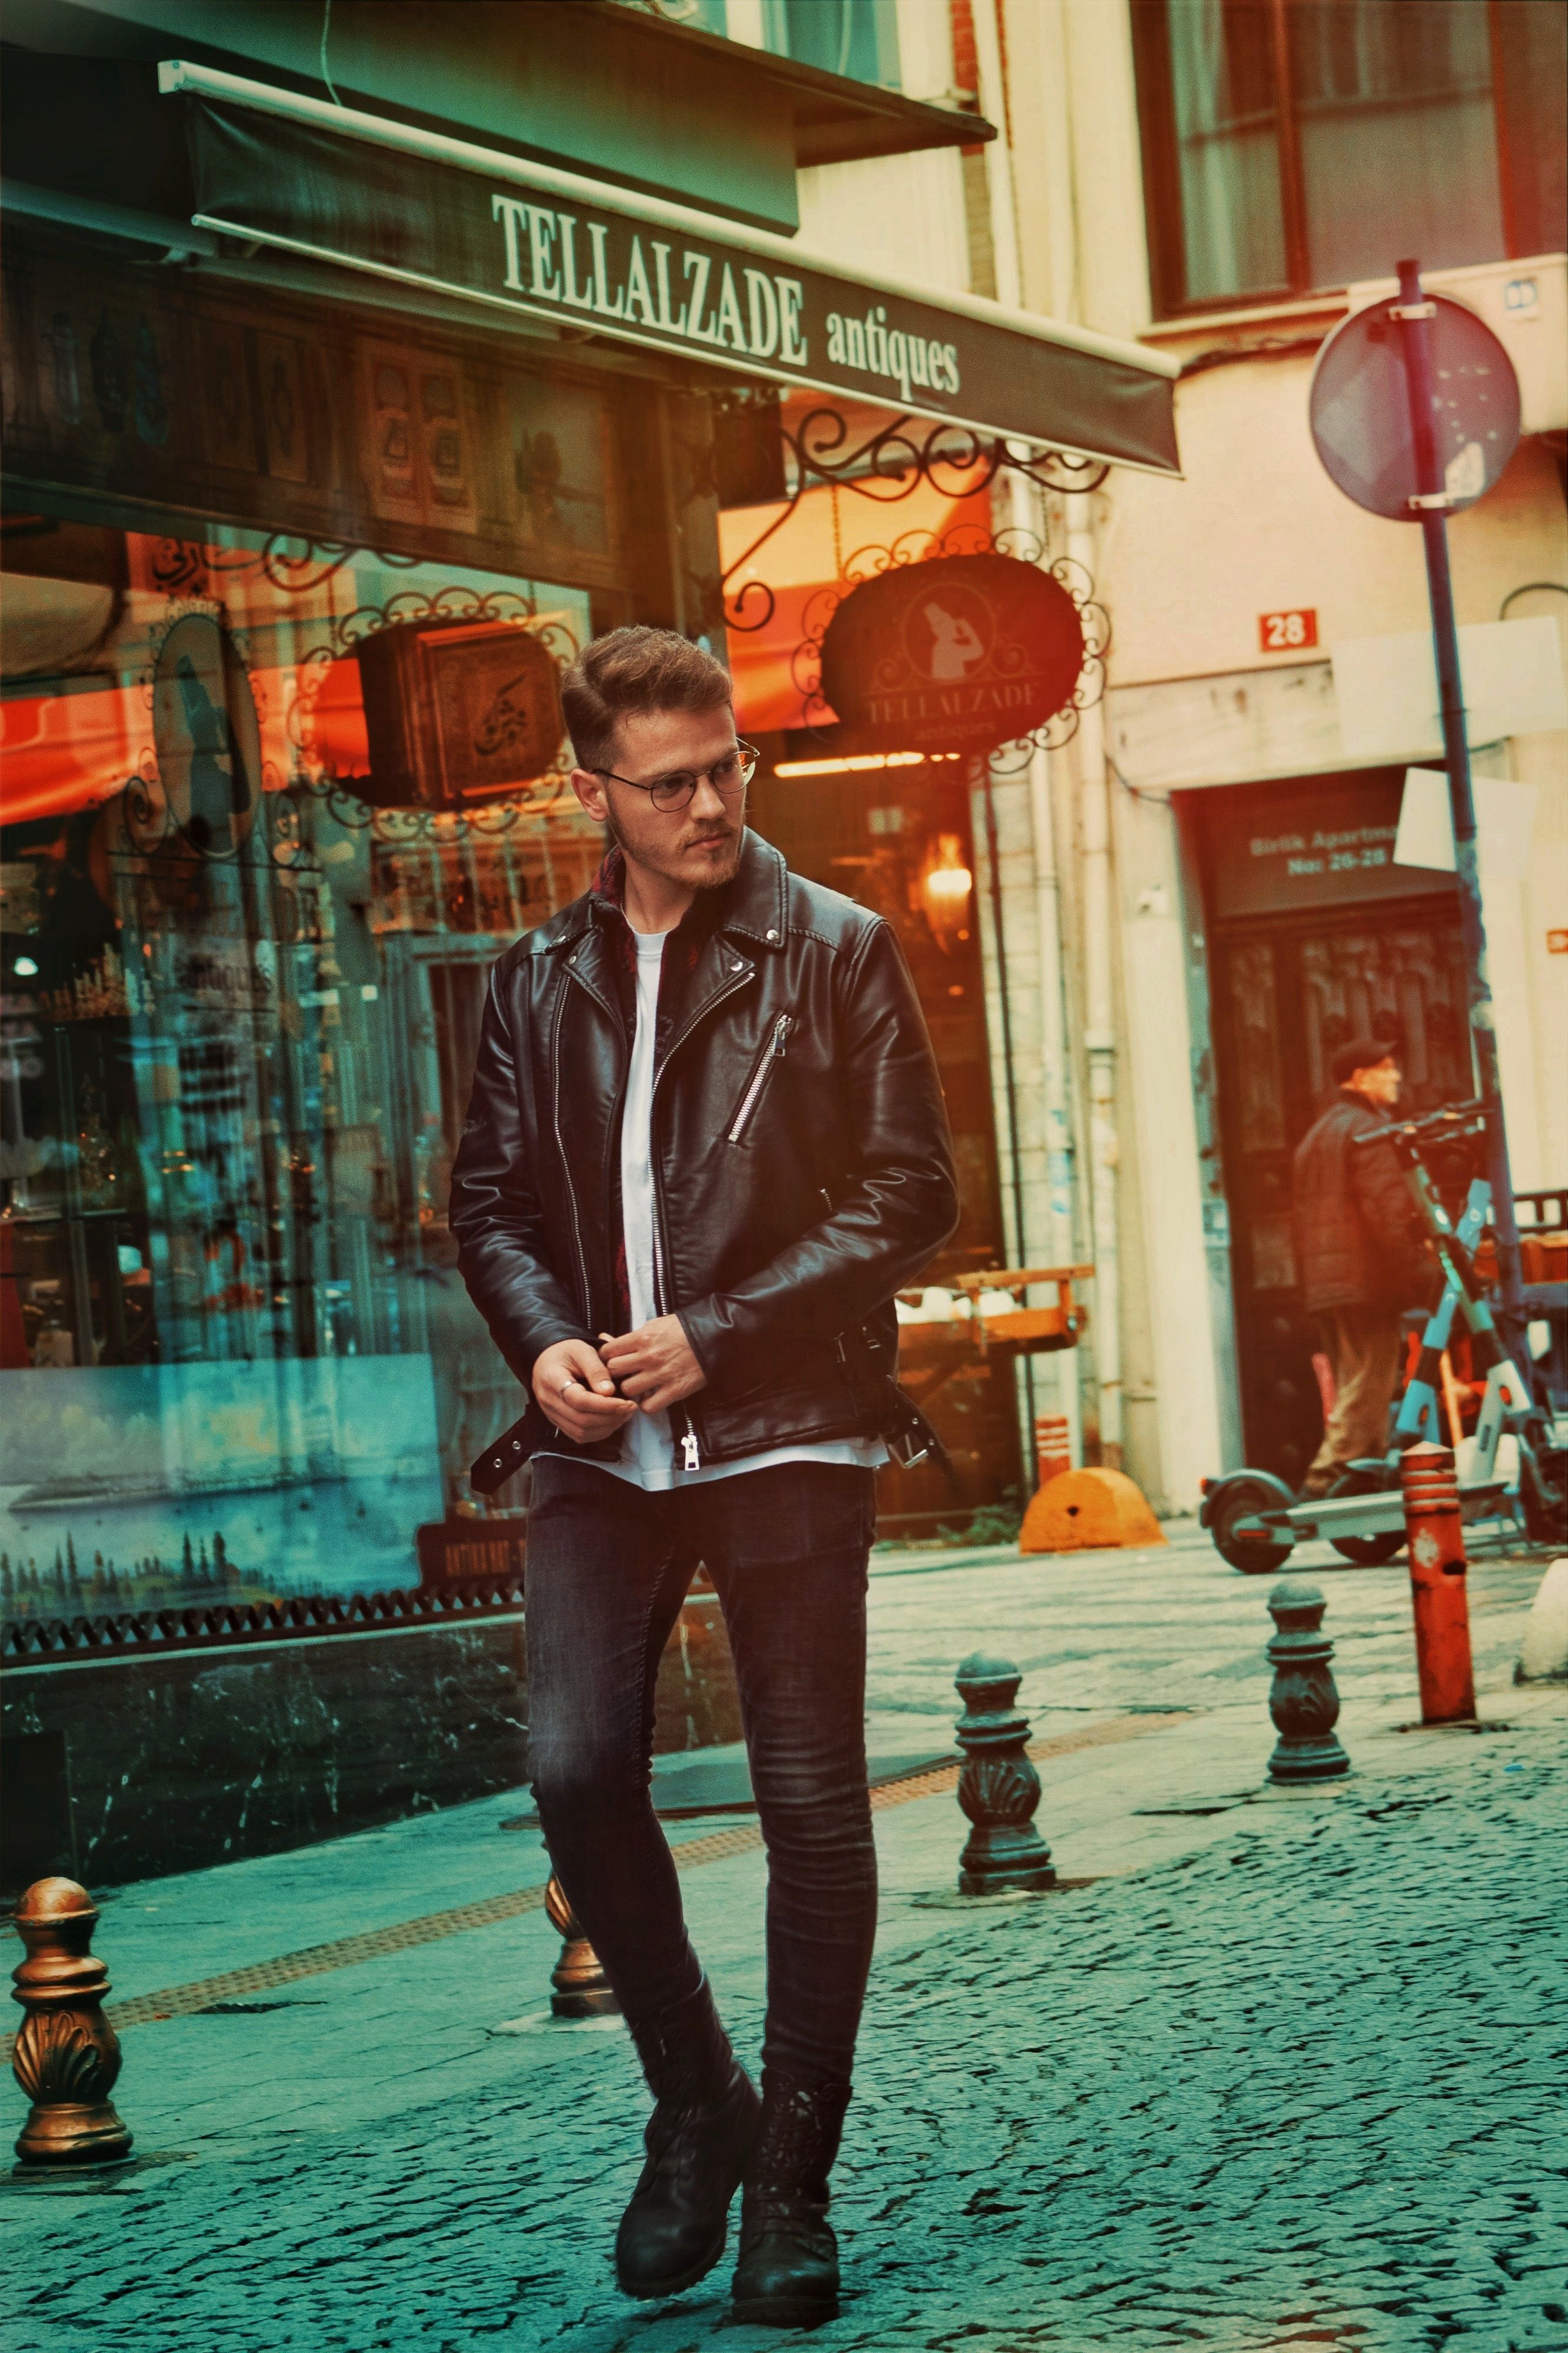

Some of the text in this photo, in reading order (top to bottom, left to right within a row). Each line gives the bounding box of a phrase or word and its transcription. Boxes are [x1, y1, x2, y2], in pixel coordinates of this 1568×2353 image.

[491, 193, 960, 403] TELLALZADE antiques
[1266, 614, 1305, 645] 28
